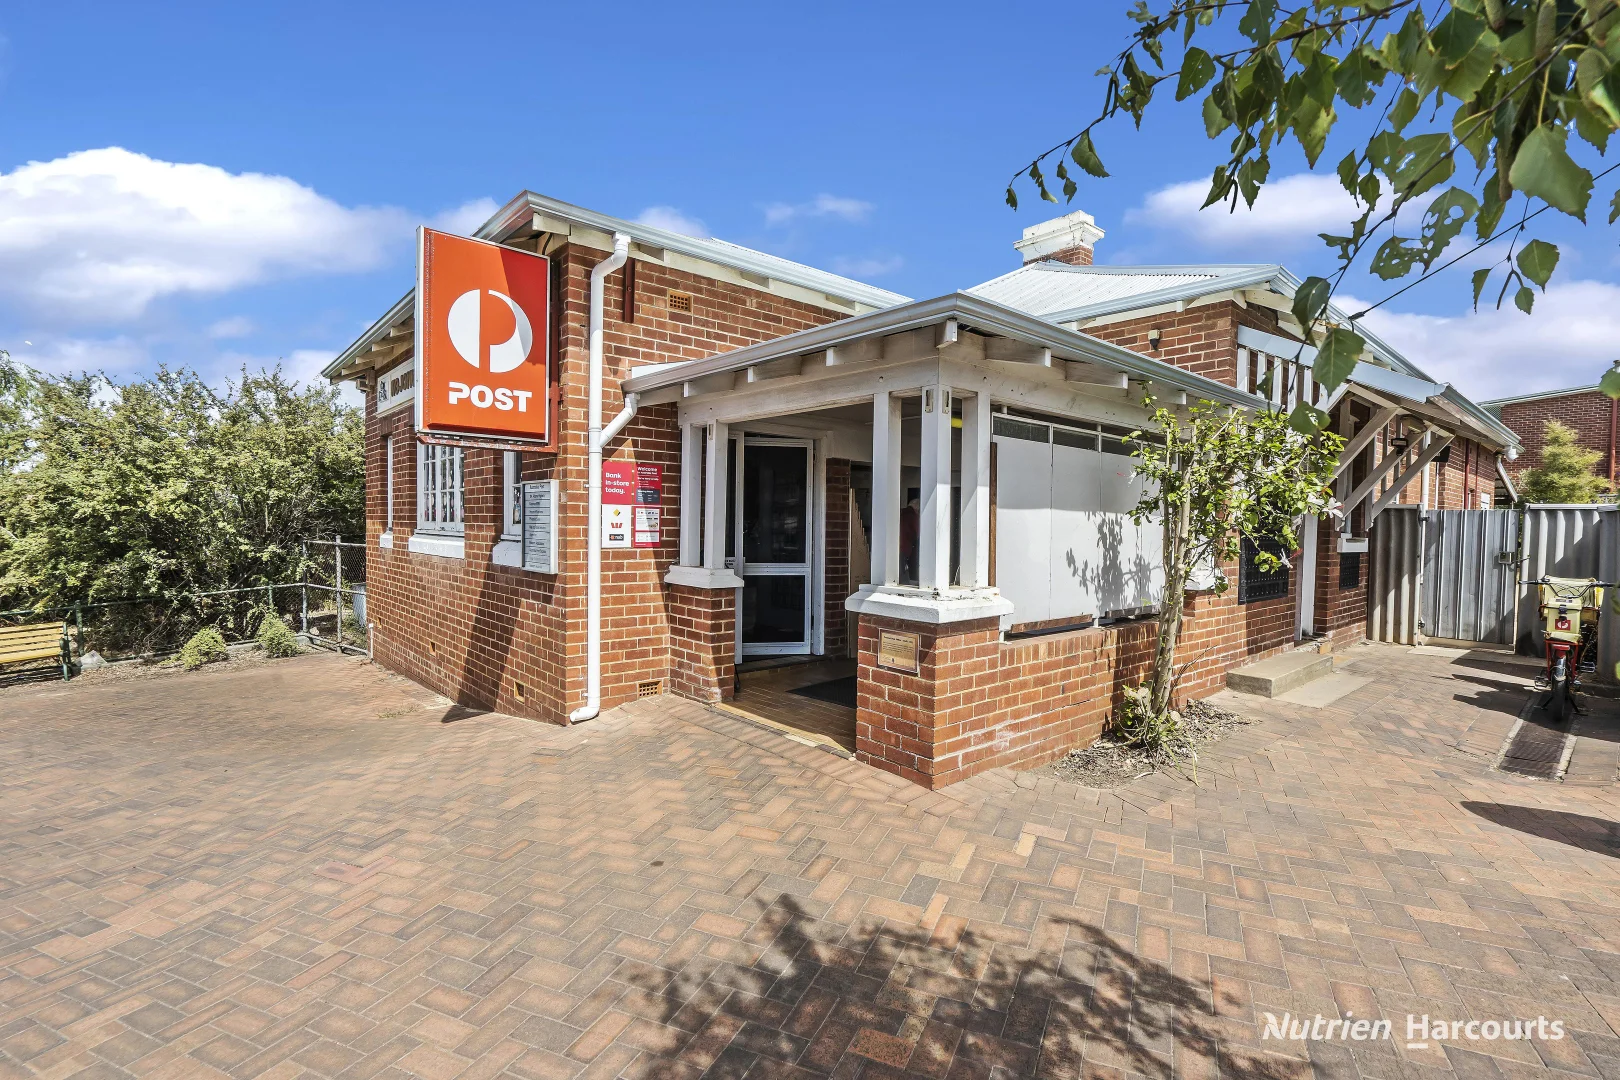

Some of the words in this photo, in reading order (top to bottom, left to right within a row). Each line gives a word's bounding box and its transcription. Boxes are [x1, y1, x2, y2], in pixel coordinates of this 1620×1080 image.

[448, 381, 533, 412] POST
[605, 479, 630, 487] in-store
[605, 486, 626, 495] today.
